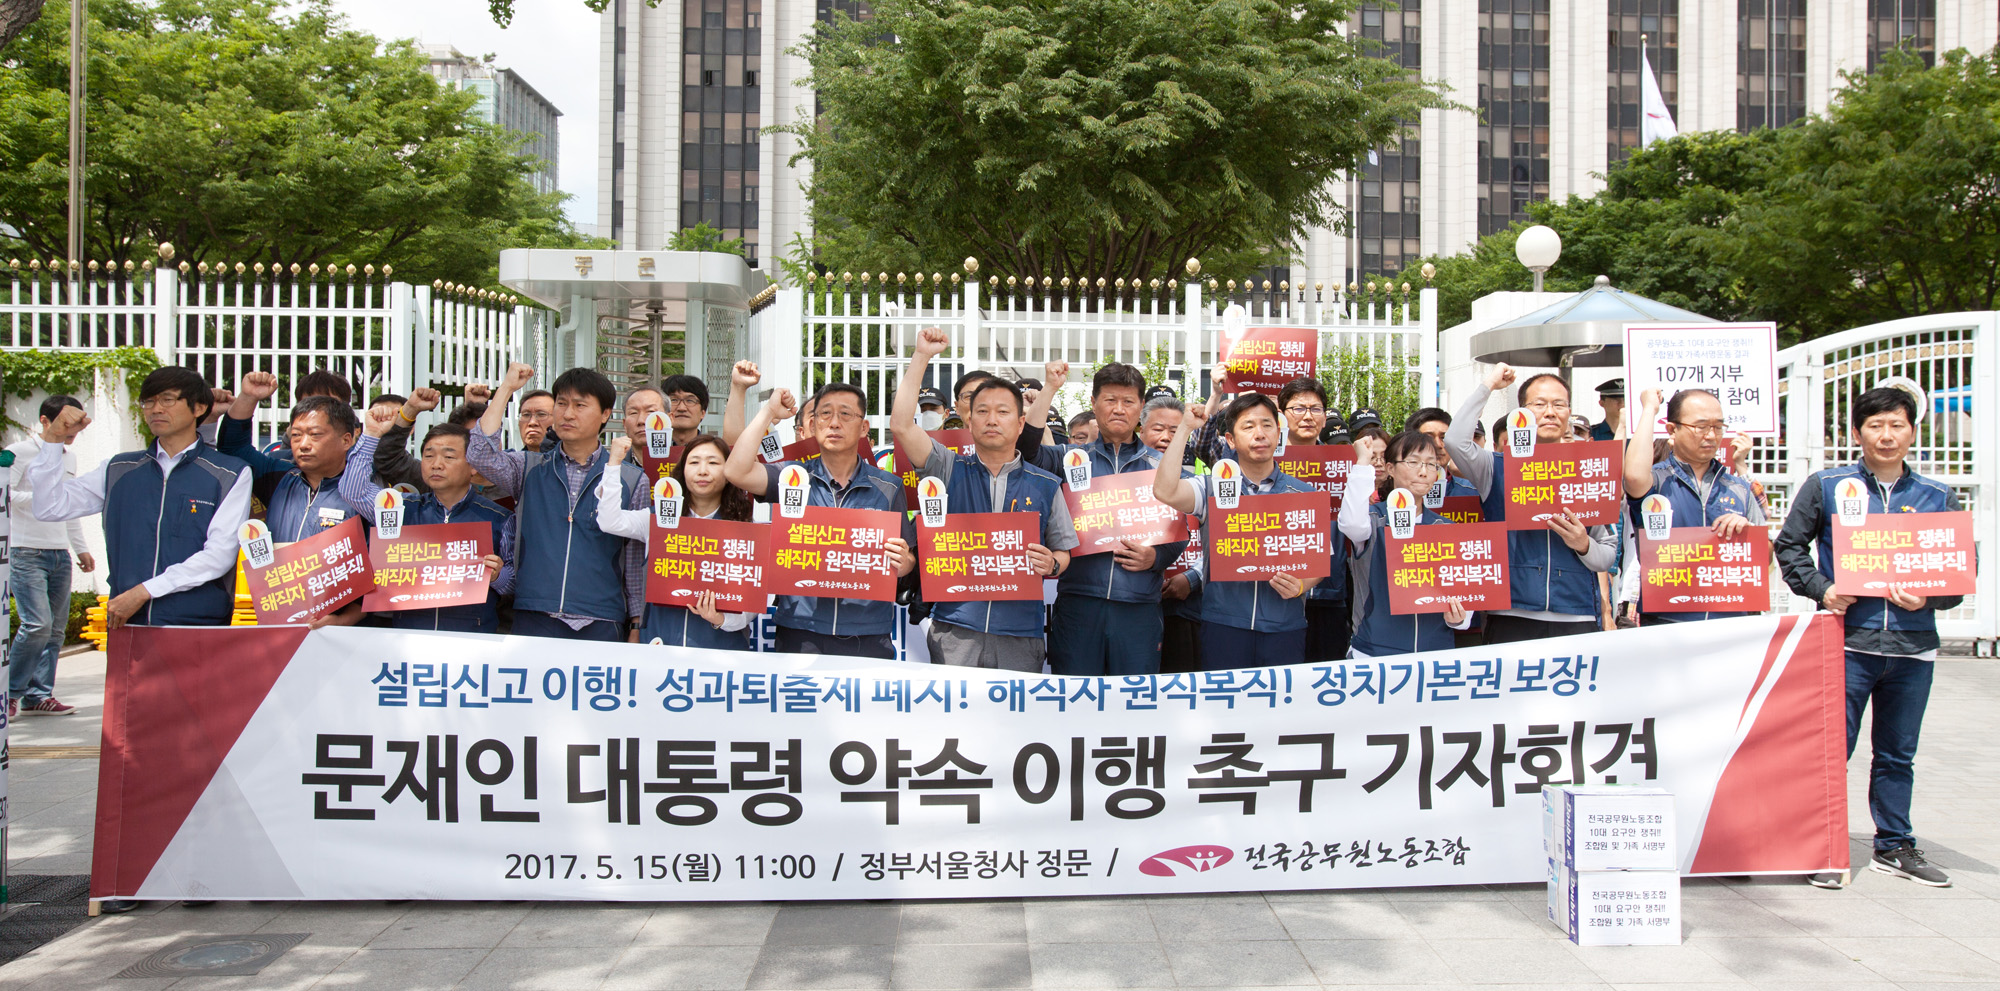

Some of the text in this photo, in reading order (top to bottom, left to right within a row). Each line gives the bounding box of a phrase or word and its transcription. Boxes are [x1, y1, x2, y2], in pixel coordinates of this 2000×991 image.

[1280, 341, 1305, 358] 쟁취!
[1687, 339, 1704, 347] 10대
[1261, 359, 1310, 378] 원직복직!
[1657, 365, 1743, 383] 107개 지부
[1728, 387, 1760, 405] 참여
[1520, 458, 1608, 480] 설립신고 쟁취!
[787, 490, 801, 498] 10대
[1220, 482, 1234, 490] 10대
[1511, 481, 1616, 505] 해직자 원직복직!
[662, 501, 675, 509] 10대
[1080, 489, 1133, 510] 설립신고
[382, 512, 396, 520] 10대
[1074, 511, 1114, 532] 해직자
[1225, 509, 1315, 532] 설립신고 쟁취!
[788, 523, 884, 549] 설립신고 쟁취!
[933, 530, 1023, 551] 설립신고 쟁취!
[1216, 537, 1260, 557] 해직자
[1263, 533, 1324, 556] 원직복직!
[1850, 528, 1955, 549] 설립신고 쟁취!
[385, 540, 478, 563] 설립신고 쟁취!
[664, 534, 754, 560] 설립신고 쟁취!
[1401, 540, 1492, 563] 설립신고 쟁취!
[1656, 542, 1752, 562] 설립신고 쟁취!
[264, 537, 353, 588] 설립신고 쟁취!
[654, 558, 762, 587] 해직자 원직복직!
[776, 549, 890, 576] 해직자 원직복직!
[926, 555, 1034, 576] 해직자 원직복직!
[1840, 551, 1967, 573] 해직자 원직복직!
[260, 554, 364, 611] 해직자 원직복직!
[373, 563, 485, 587] 해직자 원직복직!
[1394, 564, 1502, 588] 해직자 원직복직!
[1648, 566, 1762, 587] 해직자 원직복직!
[371, 662, 533, 708] 설립신고
[542, 665, 637, 712] 이행!
[656, 668, 861, 713] 성과퇴출제
[1119, 672, 1292, 711] 원직복직!
[1311, 658, 1502, 706] 정치기본권
[1509, 654, 1600, 695] 보장!
[302, 717, 1658, 826] 문재인 대통령 약속 이행 촉구 기자회견
[1588, 814, 1662, 824] 전국공무원노동조합
[1590, 828, 1607, 837] 10대
[1612, 828, 1636, 837] 요구안
[1566, 850, 1572, 860] A
[1585, 842, 1666, 850] 조합원 및 가족 서명부
[505, 835, 1471, 882] 2017. 5. 15(월) 11:00 / 정부서울청사 정문 / 전국공무원노동조합
[1592, 890, 1666, 900] 전국공무원노동조합
[1594, 905, 1611, 913] 10대
[1616, 904, 1640, 913] 요구안
[1570, 925, 1576, 935] A
[1589, 918, 1670, 927] 조합원 및 가족 서명부
